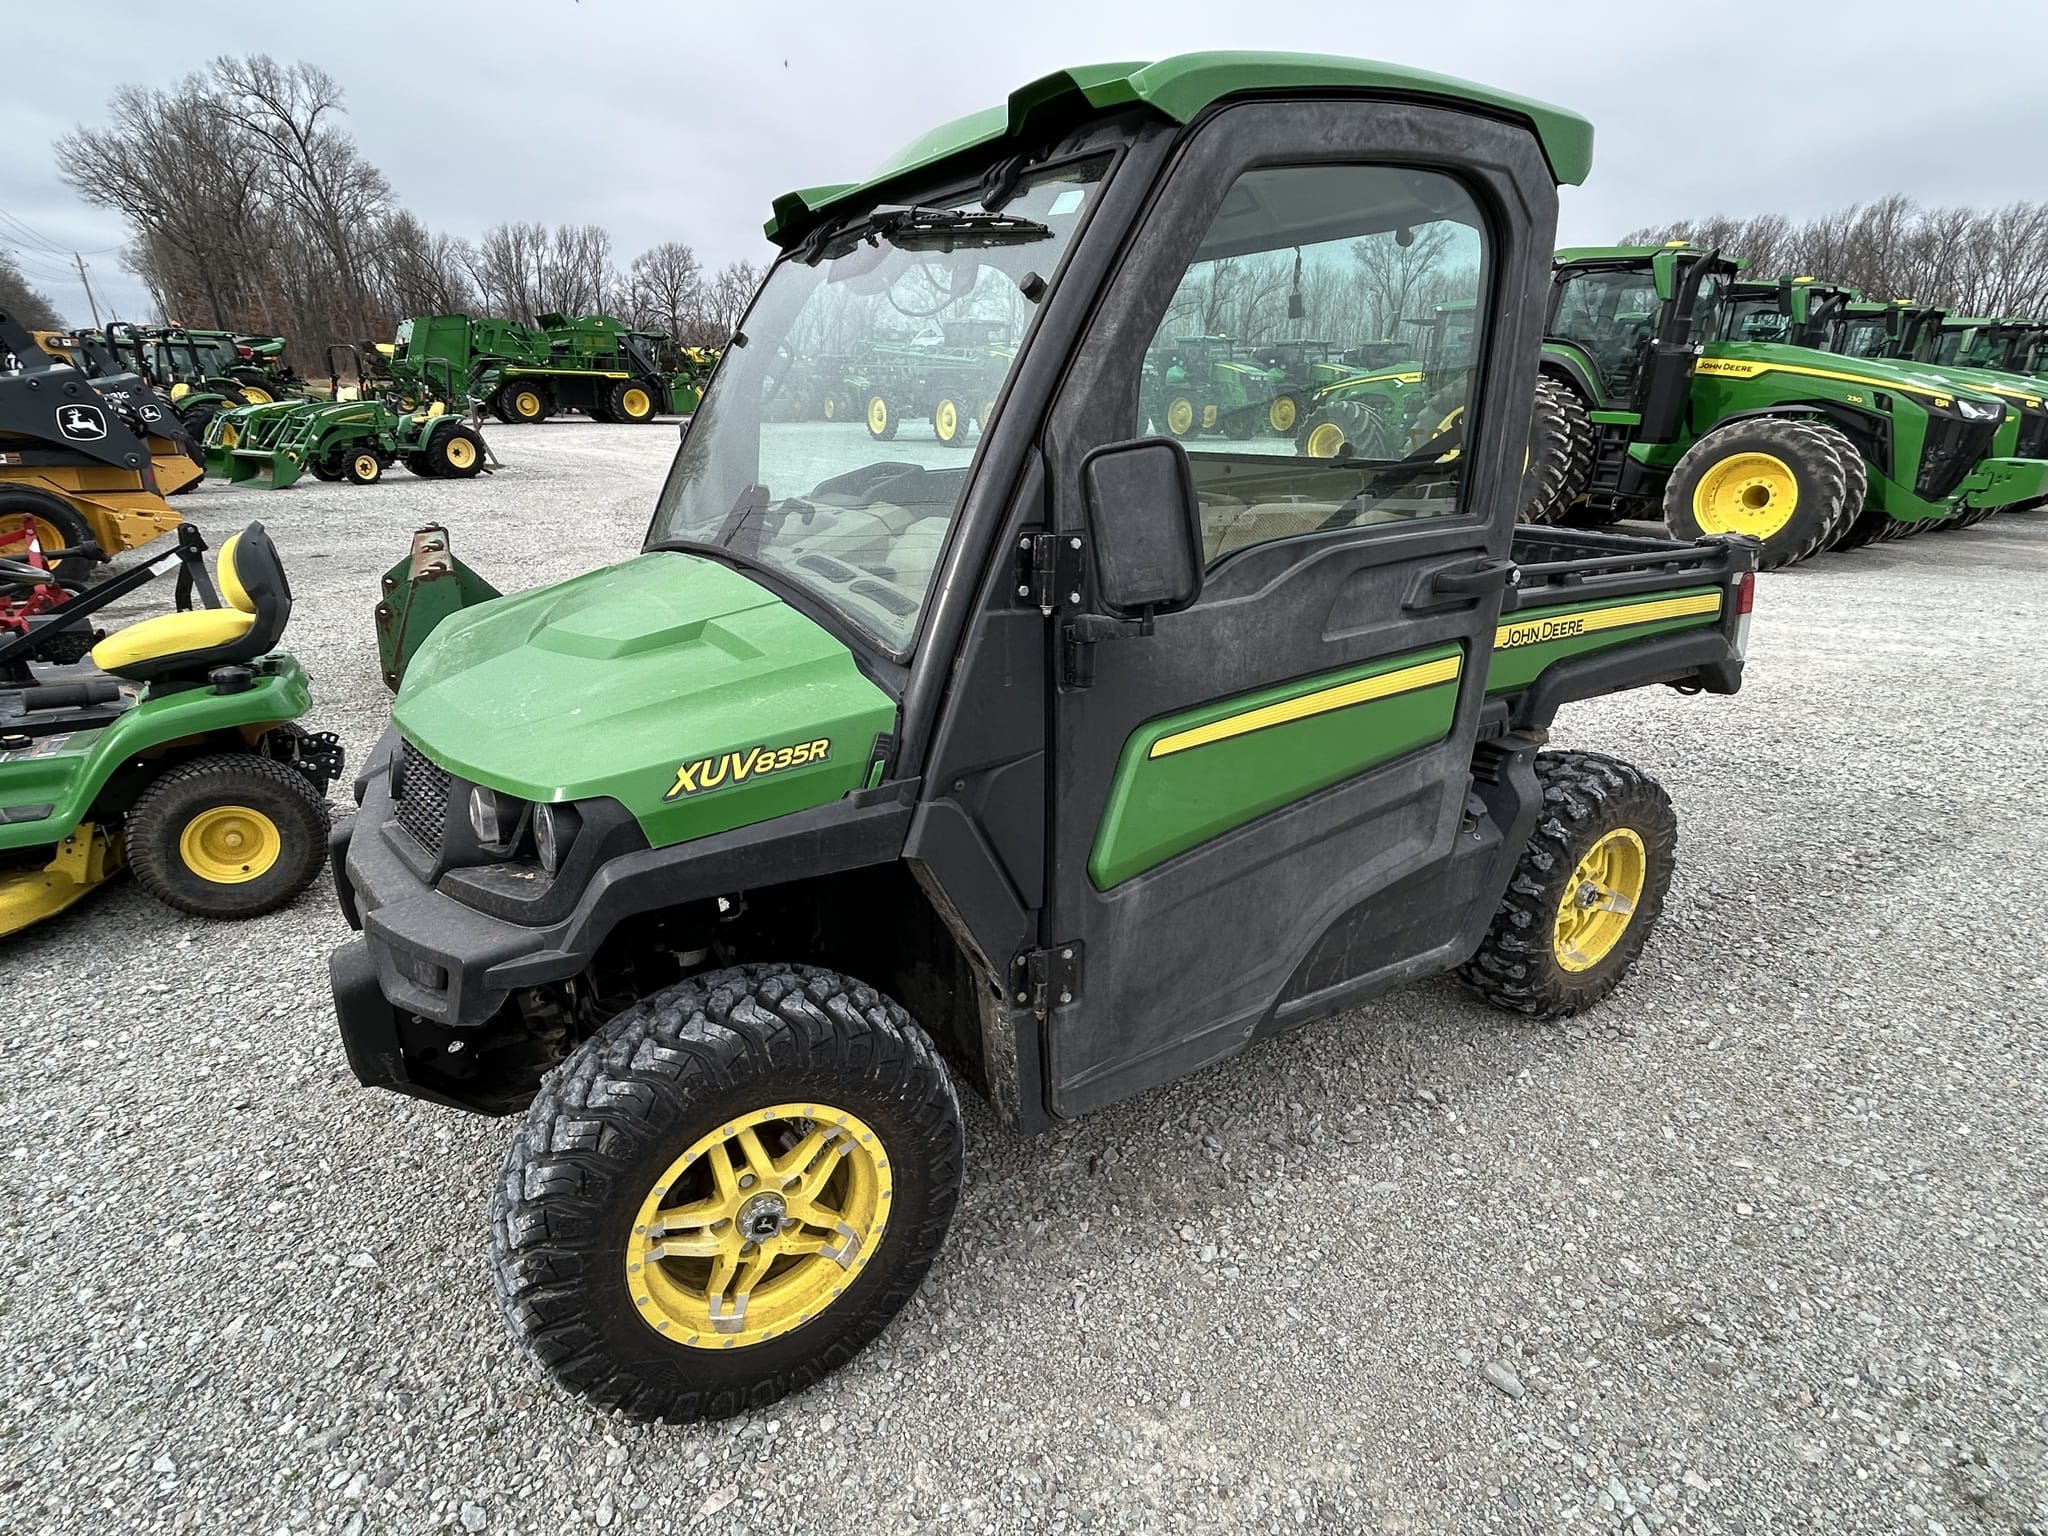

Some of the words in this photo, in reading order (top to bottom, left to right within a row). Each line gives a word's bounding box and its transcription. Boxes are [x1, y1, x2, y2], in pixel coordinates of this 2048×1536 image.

[1699, 361, 1722, 369] JOHN
[1723, 363, 1753, 373] DEERE
[1502, 627, 1540, 646] JOHN
[1542, 619, 1584, 638] DEERE
